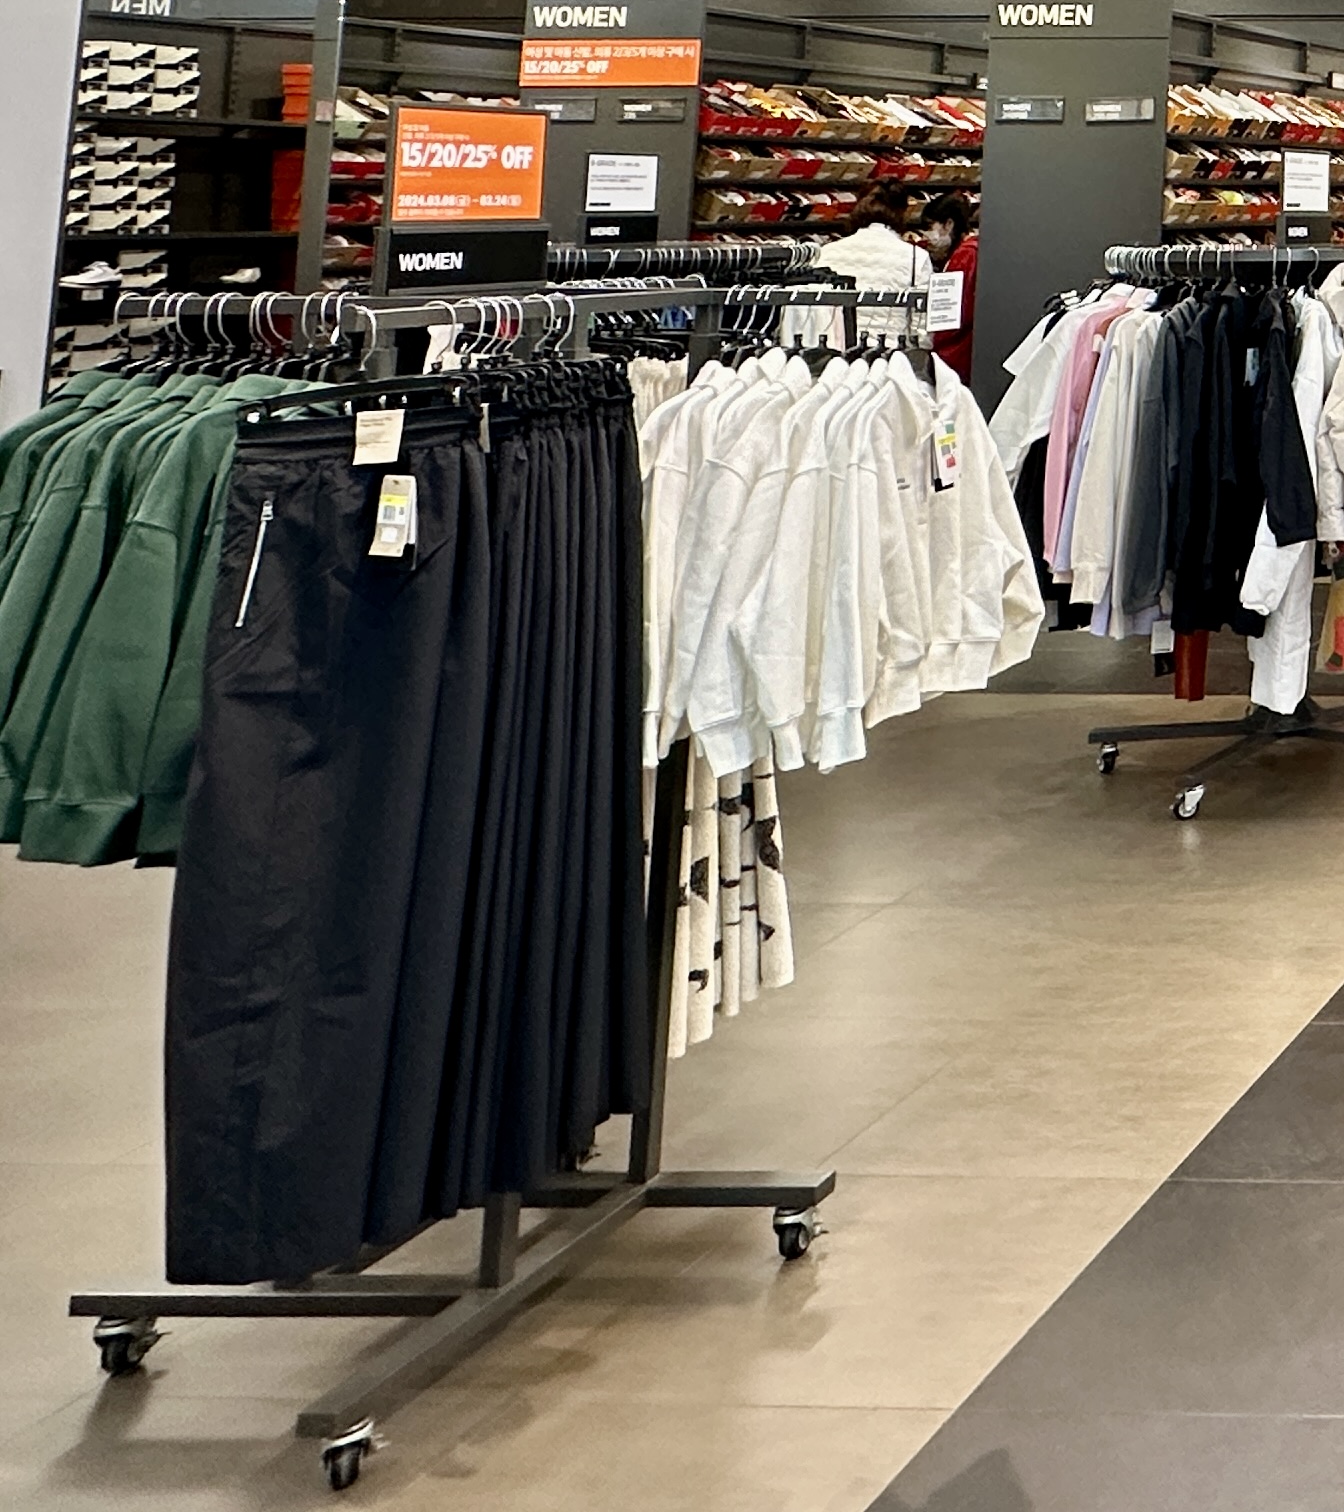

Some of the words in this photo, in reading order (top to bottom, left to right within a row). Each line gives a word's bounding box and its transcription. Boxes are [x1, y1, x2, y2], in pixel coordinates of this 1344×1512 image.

[532, 6, 628, 28] WOMEN
[997, 4, 1094, 26] WOMEN
[586, 60, 609, 74] OFF
[400, 142, 498, 168] 15/20/25%
[501, 145, 534, 169] OFF
[398, 251, 464, 272] WOMEN
